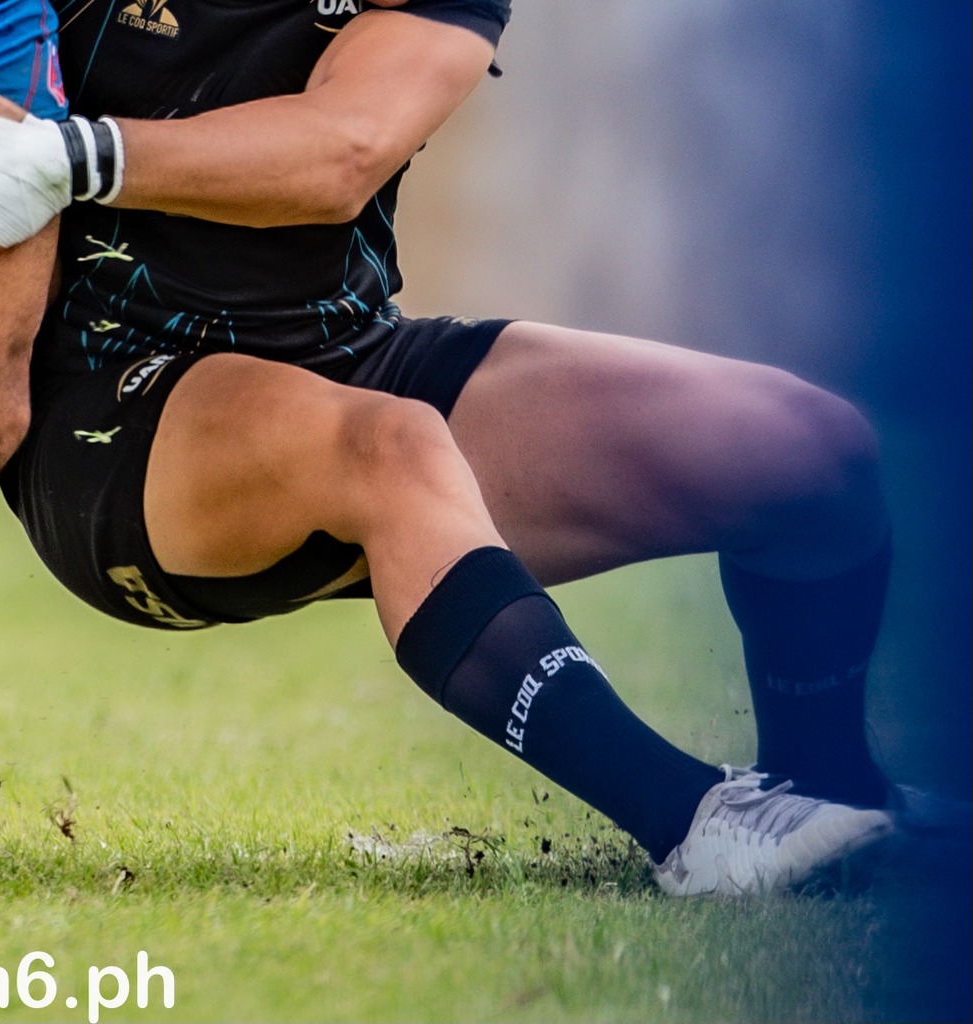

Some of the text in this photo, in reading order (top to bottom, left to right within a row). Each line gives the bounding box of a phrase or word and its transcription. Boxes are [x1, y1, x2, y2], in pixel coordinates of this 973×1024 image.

[117, 12, 129, 24] LE
[146, 20, 180, 38] SPORTIF
[511, 673, 544, 724] COQ
[505, 718, 525, 753] LE
